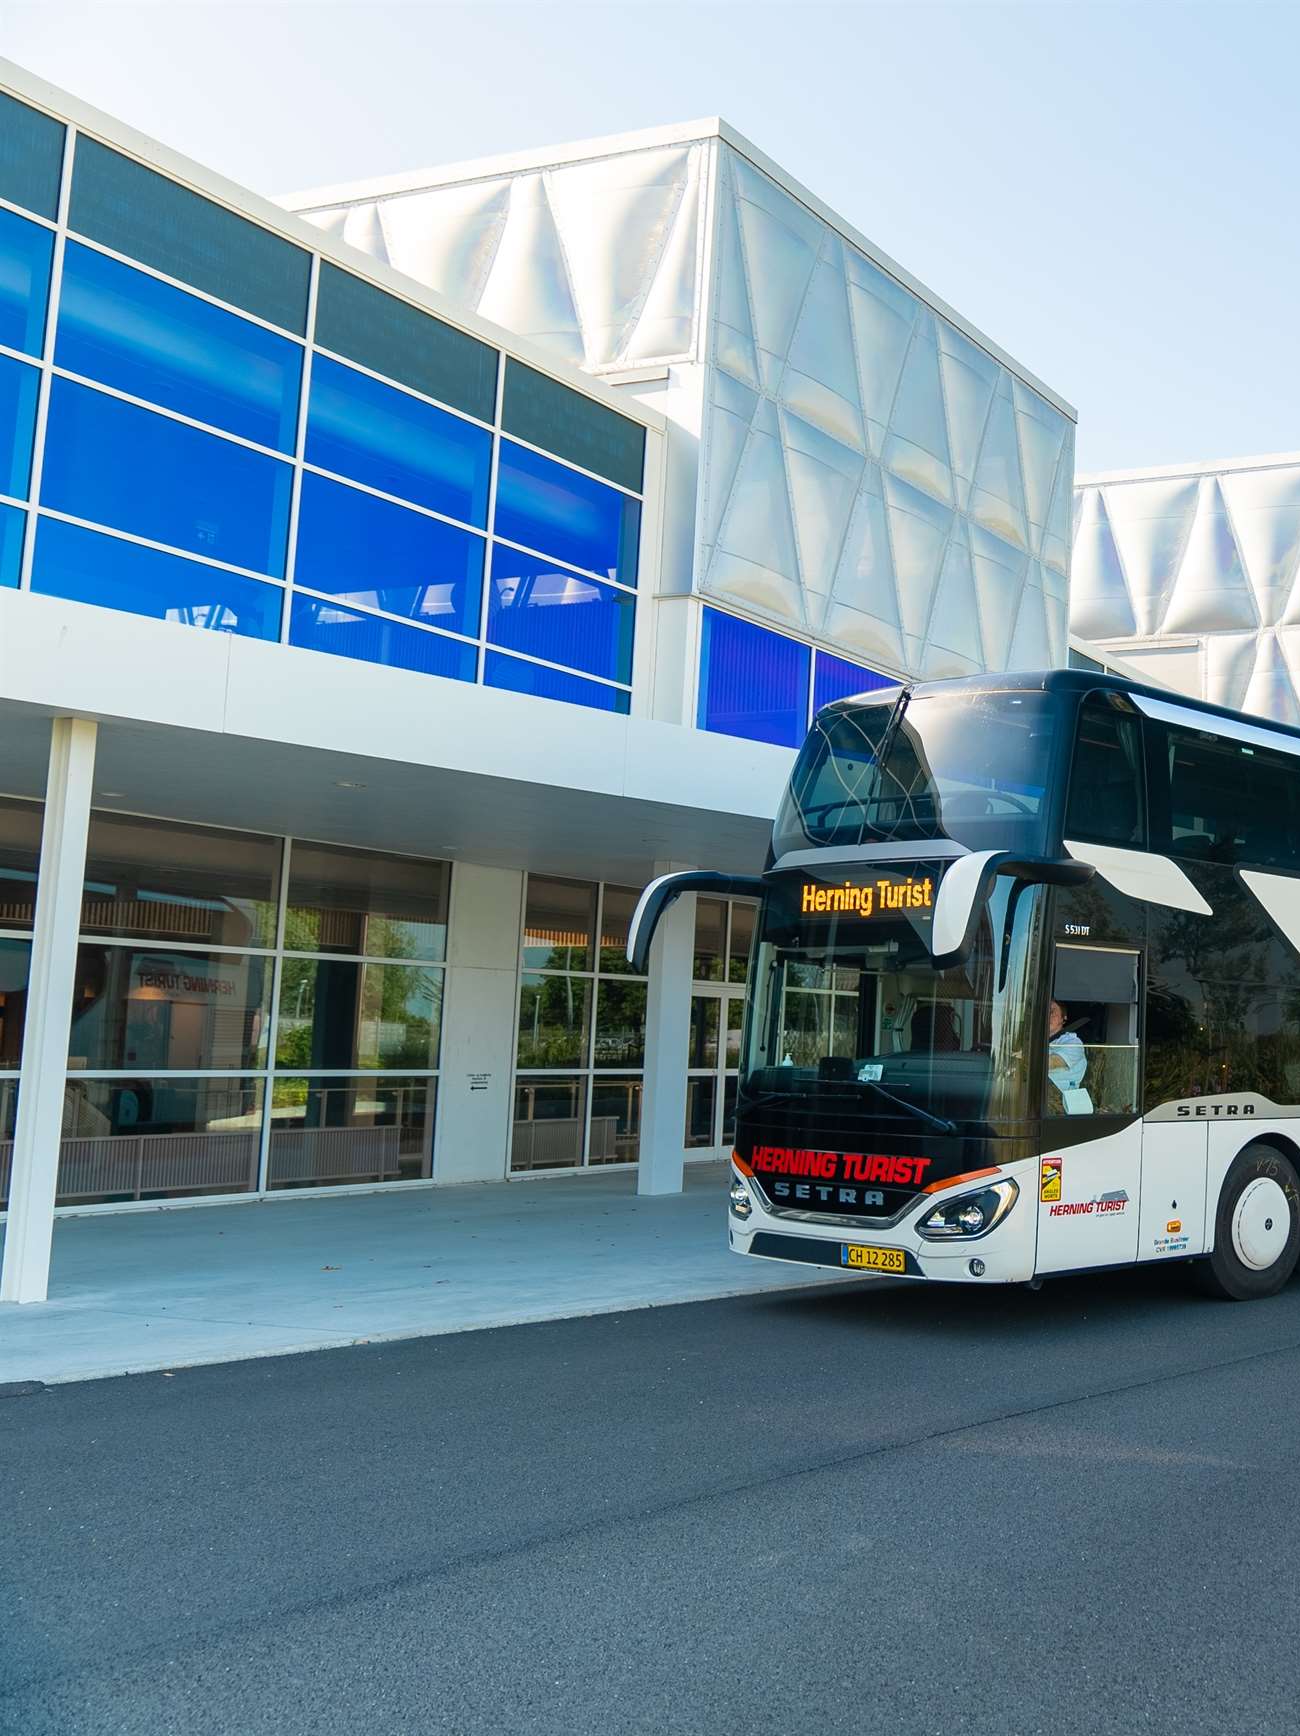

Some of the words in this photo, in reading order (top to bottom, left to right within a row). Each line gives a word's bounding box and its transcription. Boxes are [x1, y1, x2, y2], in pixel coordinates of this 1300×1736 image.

[802, 881, 873, 917] Herning
[877, 878, 932, 909] Turist
[1177, 1104, 1255, 1117] SETRA
[750, 1145, 837, 1179] HERNING
[843, 1154, 932, 1185] TURIST
[774, 1182, 885, 1206] SETRA
[1049, 1202, 1094, 1217] HERNING
[1096, 1199, 1127, 1213] TURIST
[848, 1248, 863, 1263] CH
[866, 1251, 879, 1266] 12
[881, 1252, 902, 1268] 285
